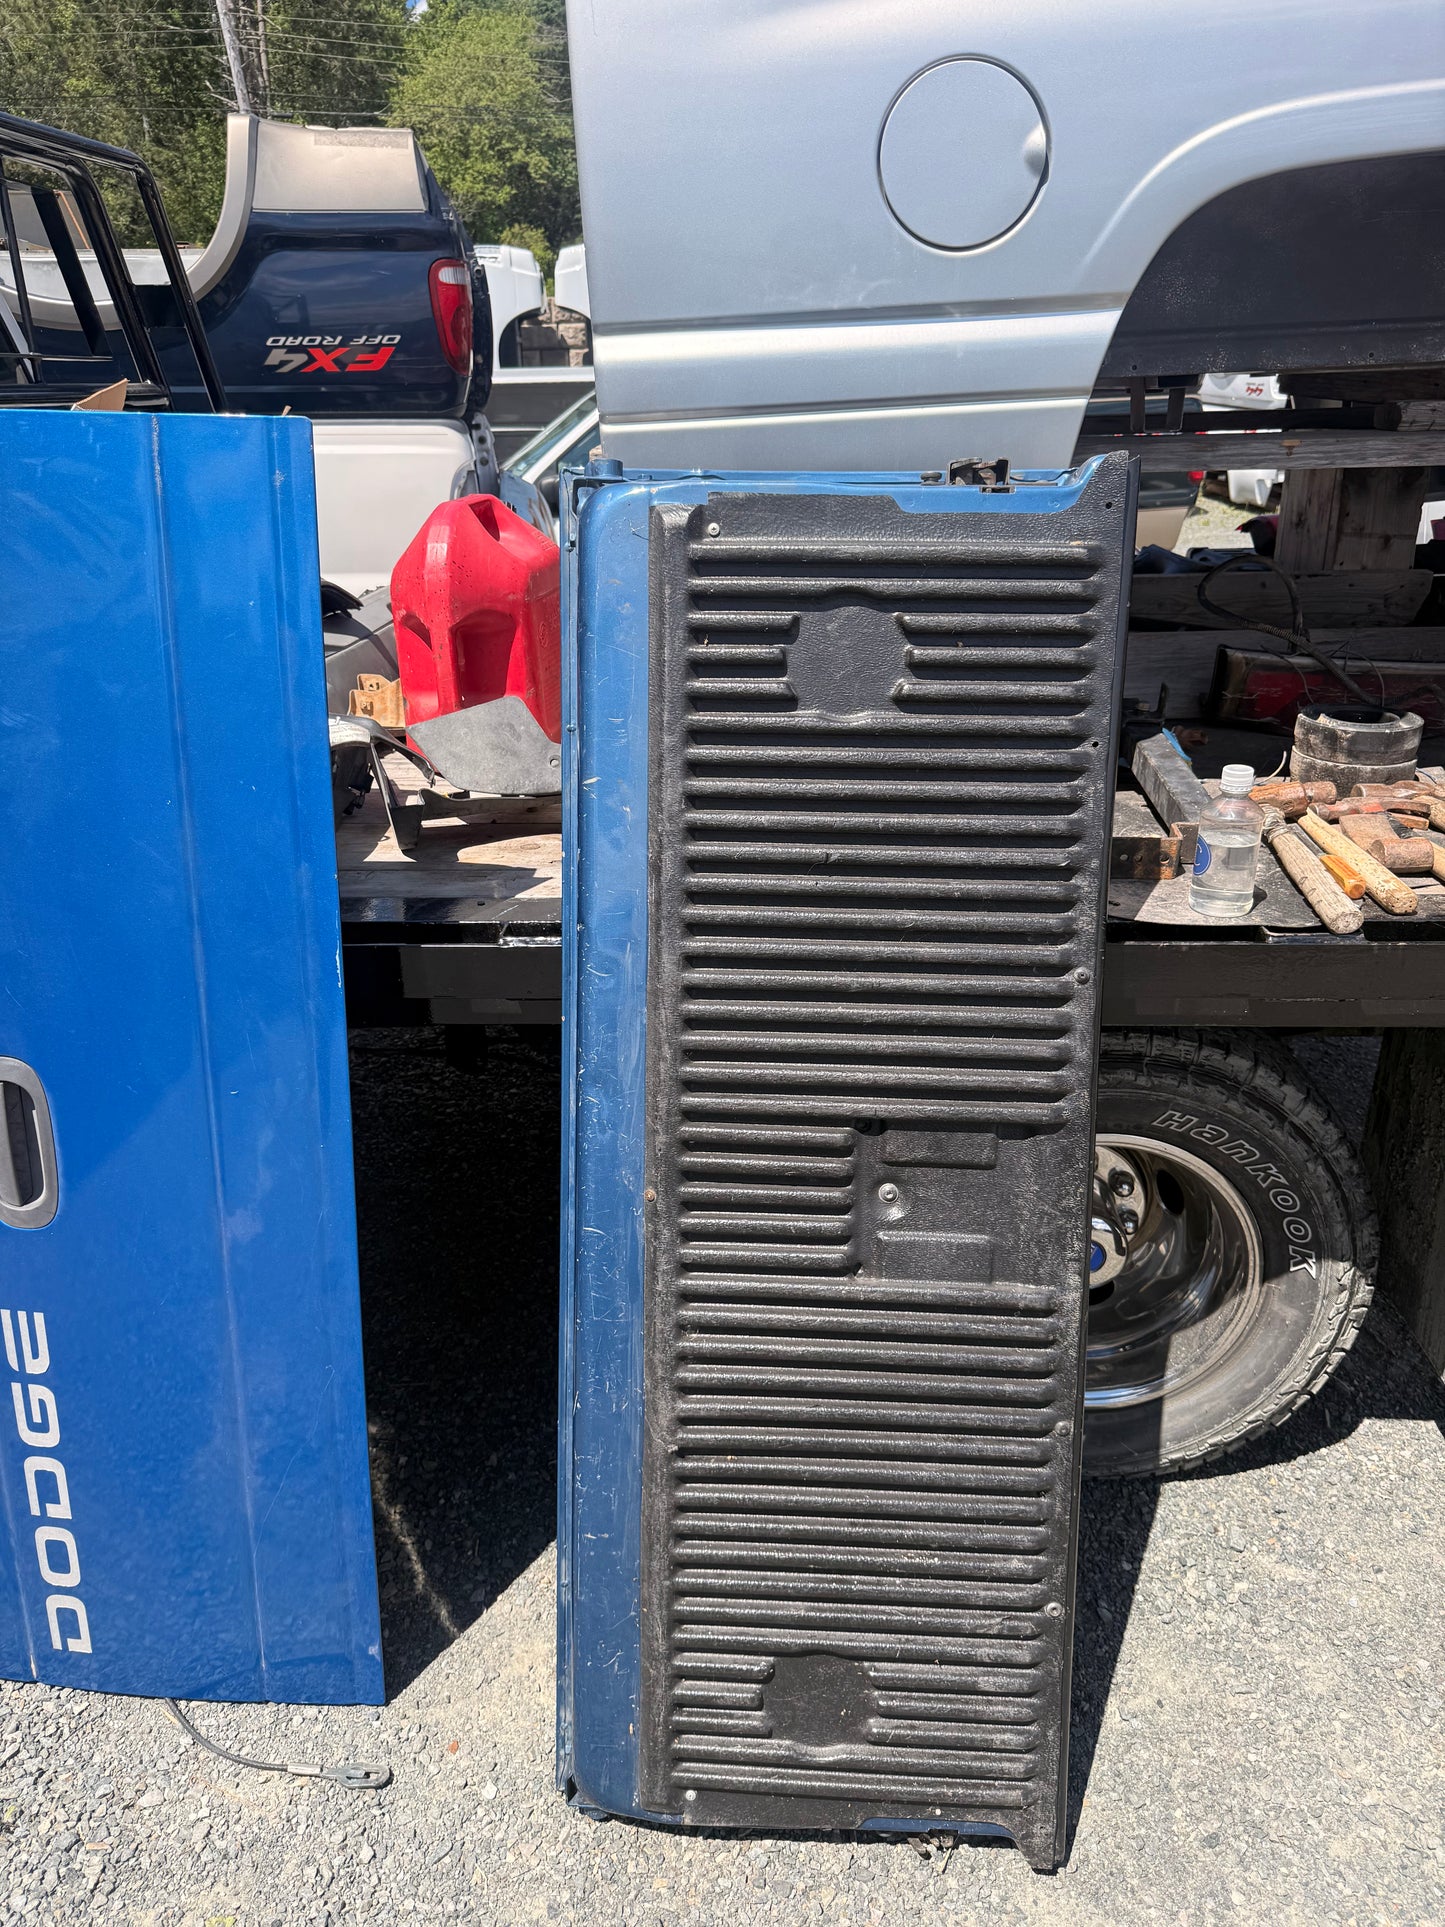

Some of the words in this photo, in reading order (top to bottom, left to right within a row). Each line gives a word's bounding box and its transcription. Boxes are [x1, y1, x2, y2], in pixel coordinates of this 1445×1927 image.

[266, 336, 343, 346] ROAD
[350, 335, 401, 345] OFF
[264, 346, 396, 373] FX4
[0, 1308, 93, 1654] DODGE
